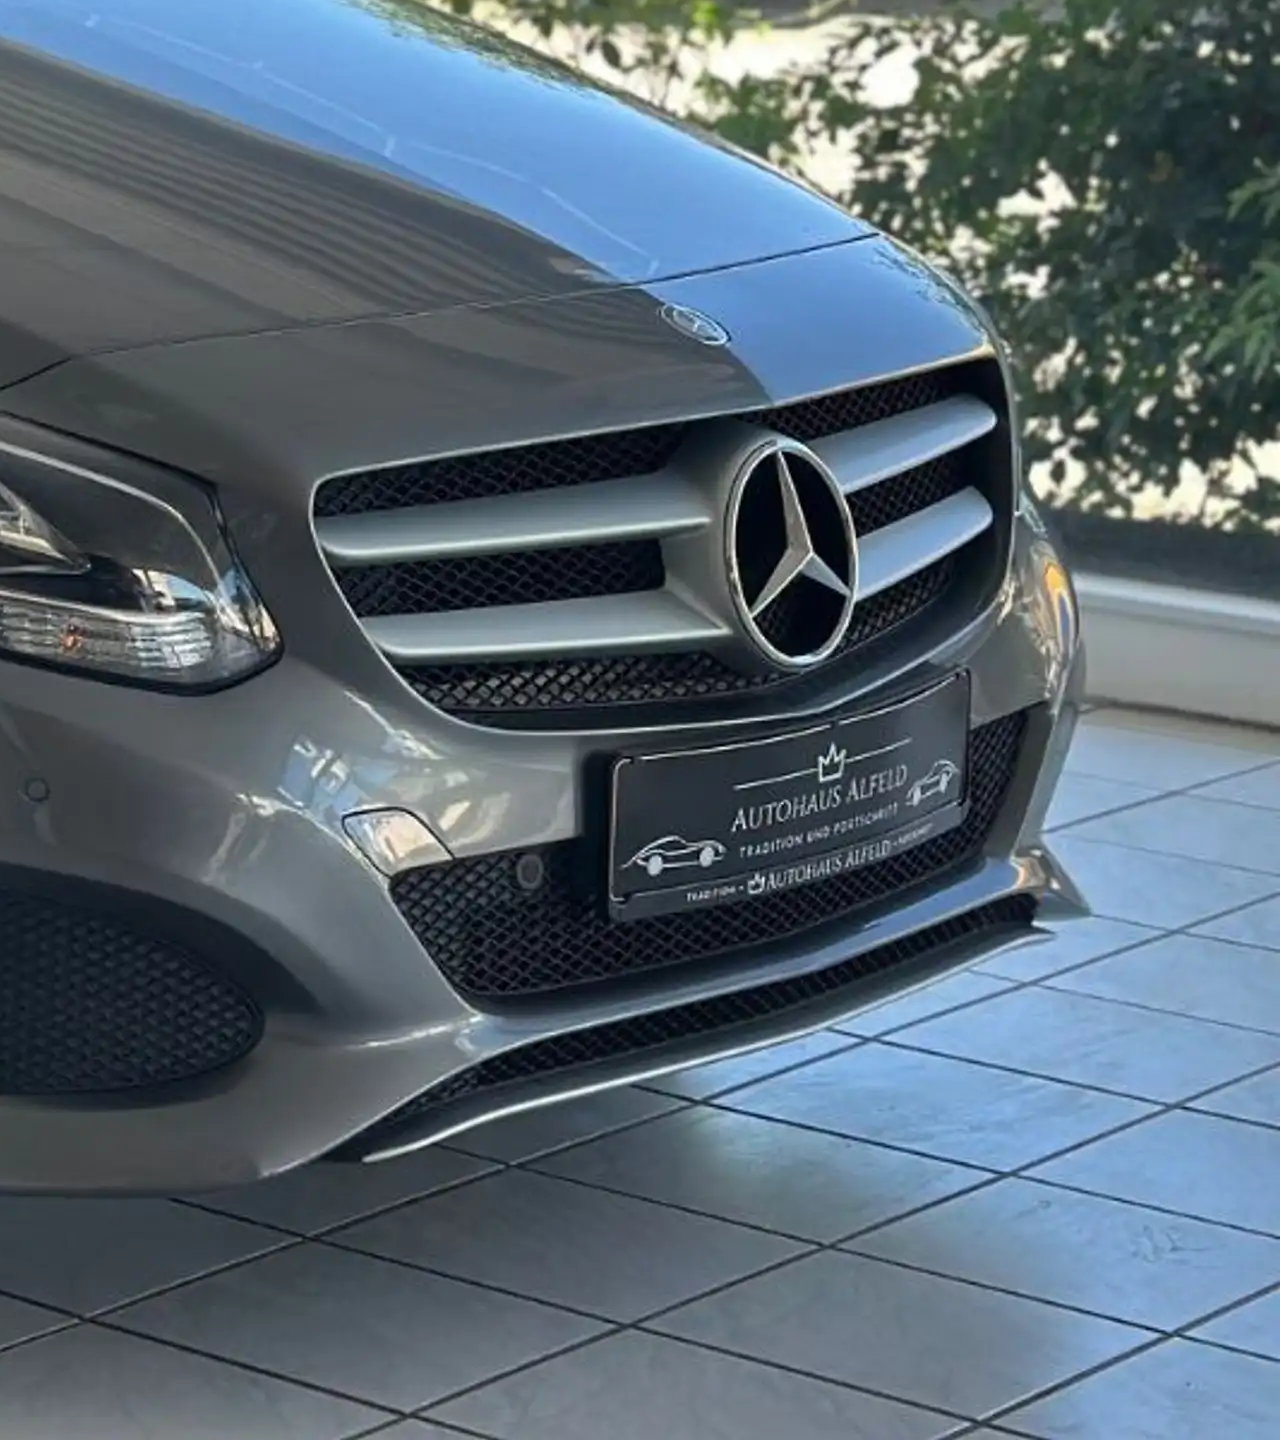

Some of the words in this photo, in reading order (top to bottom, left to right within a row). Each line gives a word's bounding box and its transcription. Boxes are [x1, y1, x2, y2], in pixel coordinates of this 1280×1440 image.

[730, 785, 842, 833] AUTOHAUS
[845, 764, 908, 805] ALFELD
[740, 833, 804, 859] TRADITION
[766, 854, 843, 892] AUTOHAUS
[845, 839, 891, 869] ALFELD
